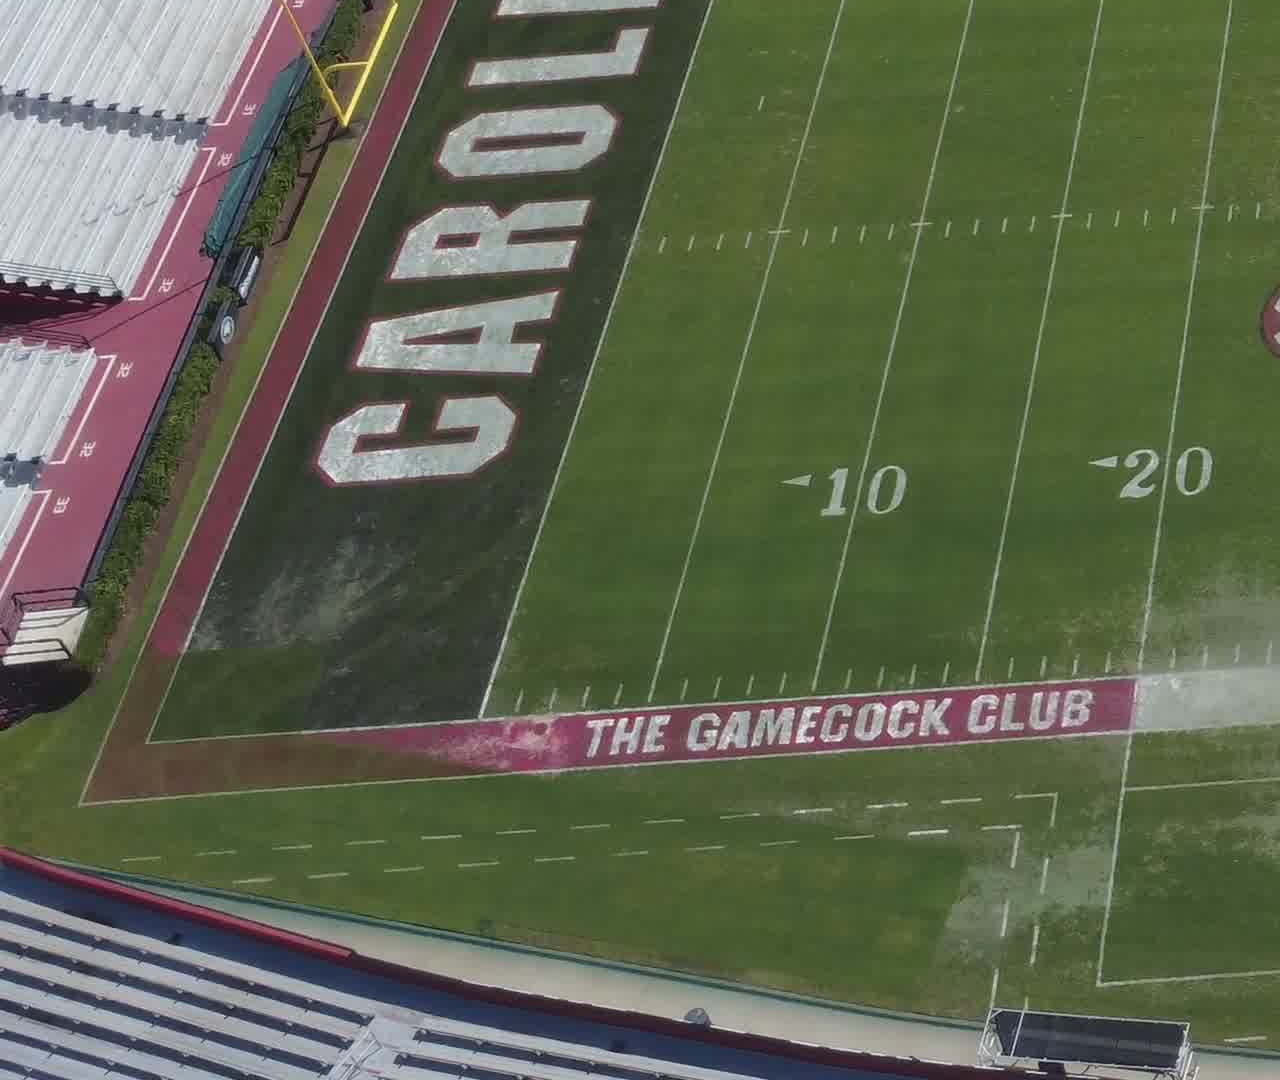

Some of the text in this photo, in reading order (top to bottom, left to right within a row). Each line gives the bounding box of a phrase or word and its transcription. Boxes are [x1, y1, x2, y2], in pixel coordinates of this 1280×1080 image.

[818, 464, 909, 518] 10
[1118, 446, 1214, 500] 20
[585, 688, 1095, 759] THE GAMECOCK CLUB
